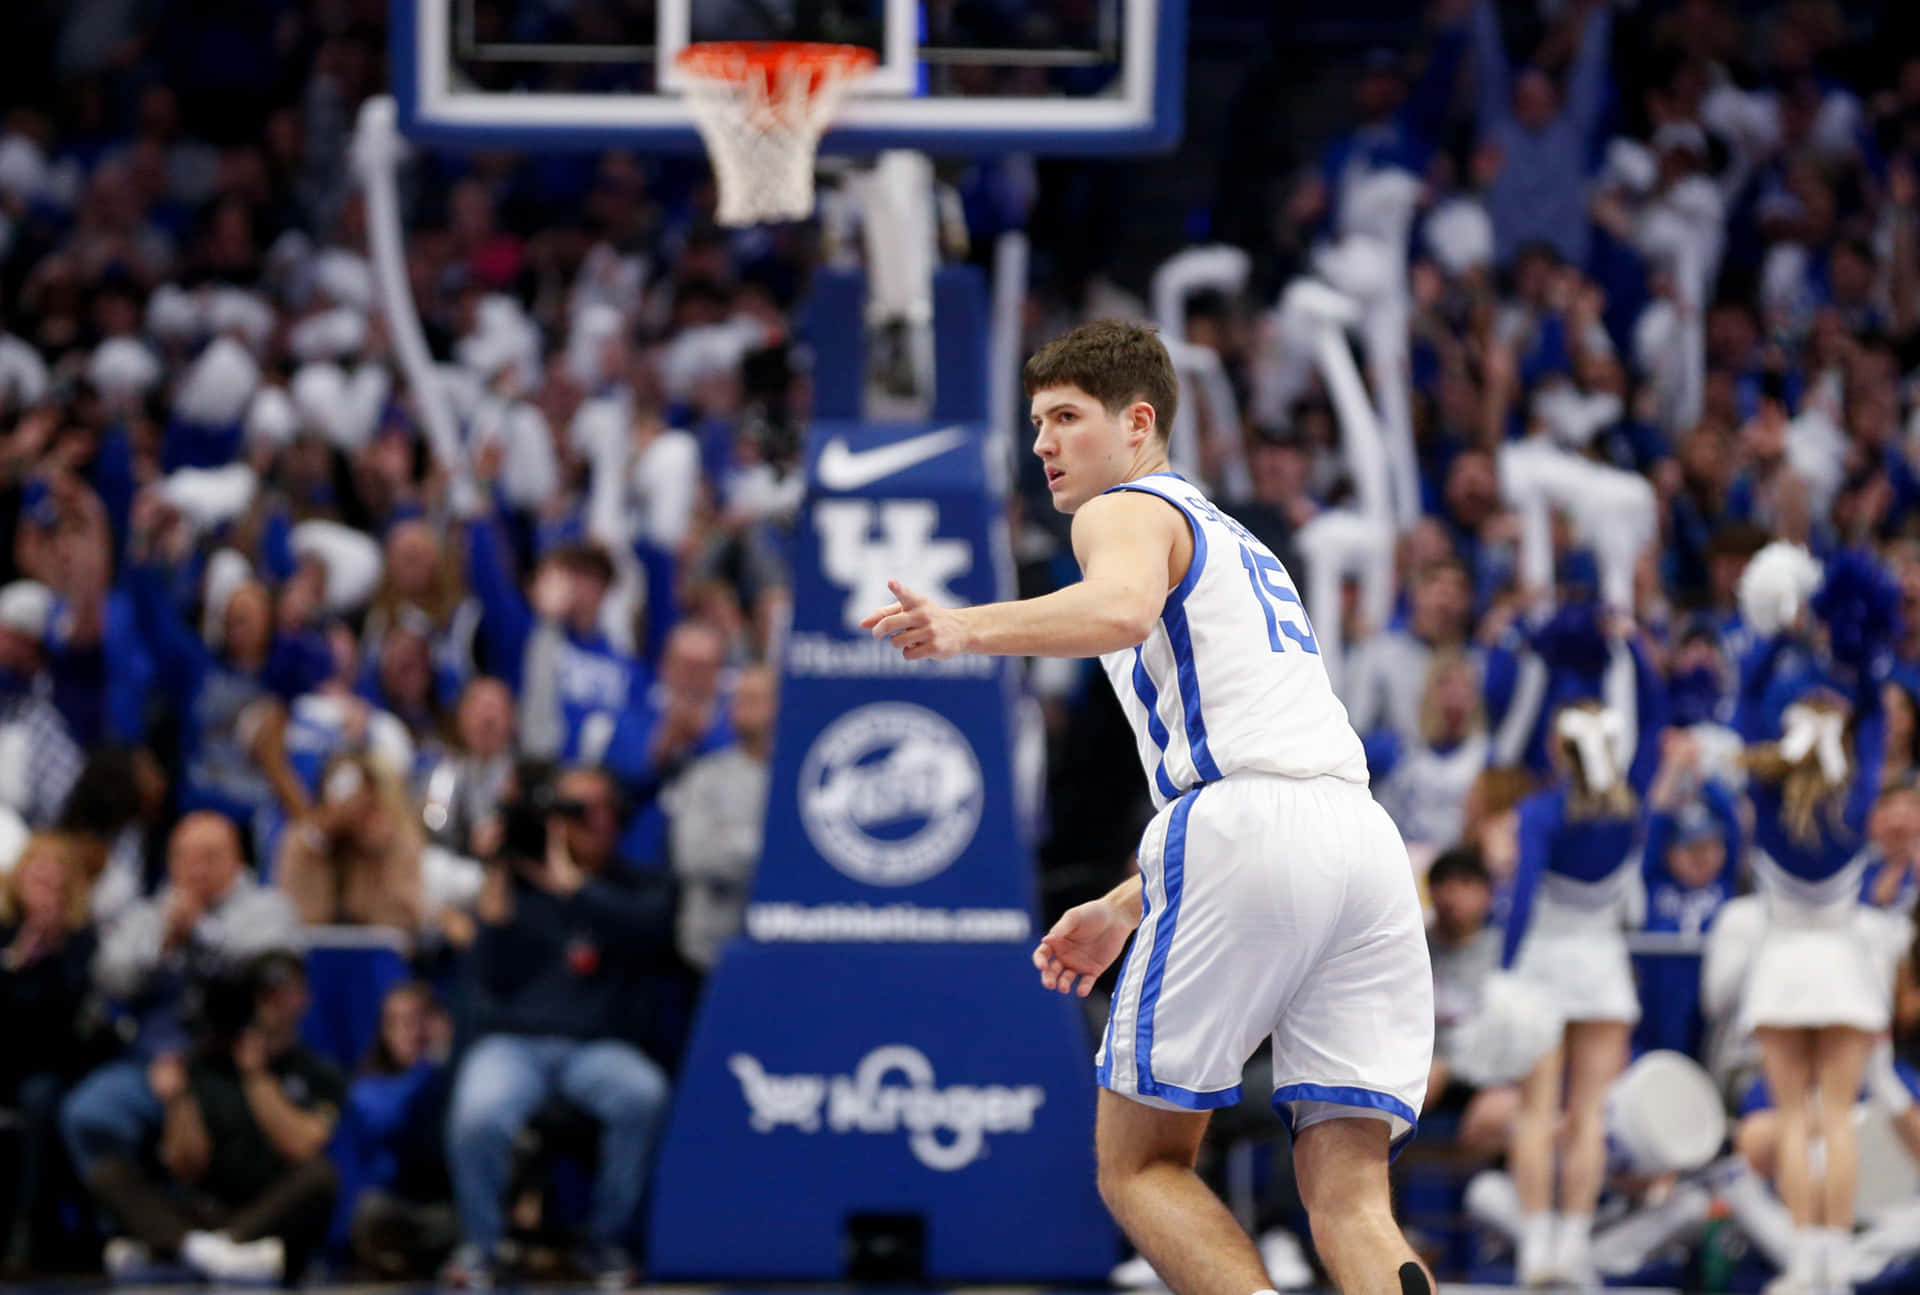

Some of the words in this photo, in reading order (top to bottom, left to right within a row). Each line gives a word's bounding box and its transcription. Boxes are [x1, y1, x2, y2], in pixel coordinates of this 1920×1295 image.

[815, 500, 972, 634] UK
[1239, 542, 1319, 655] 15
[828, 1044, 1044, 1170] Kroger
